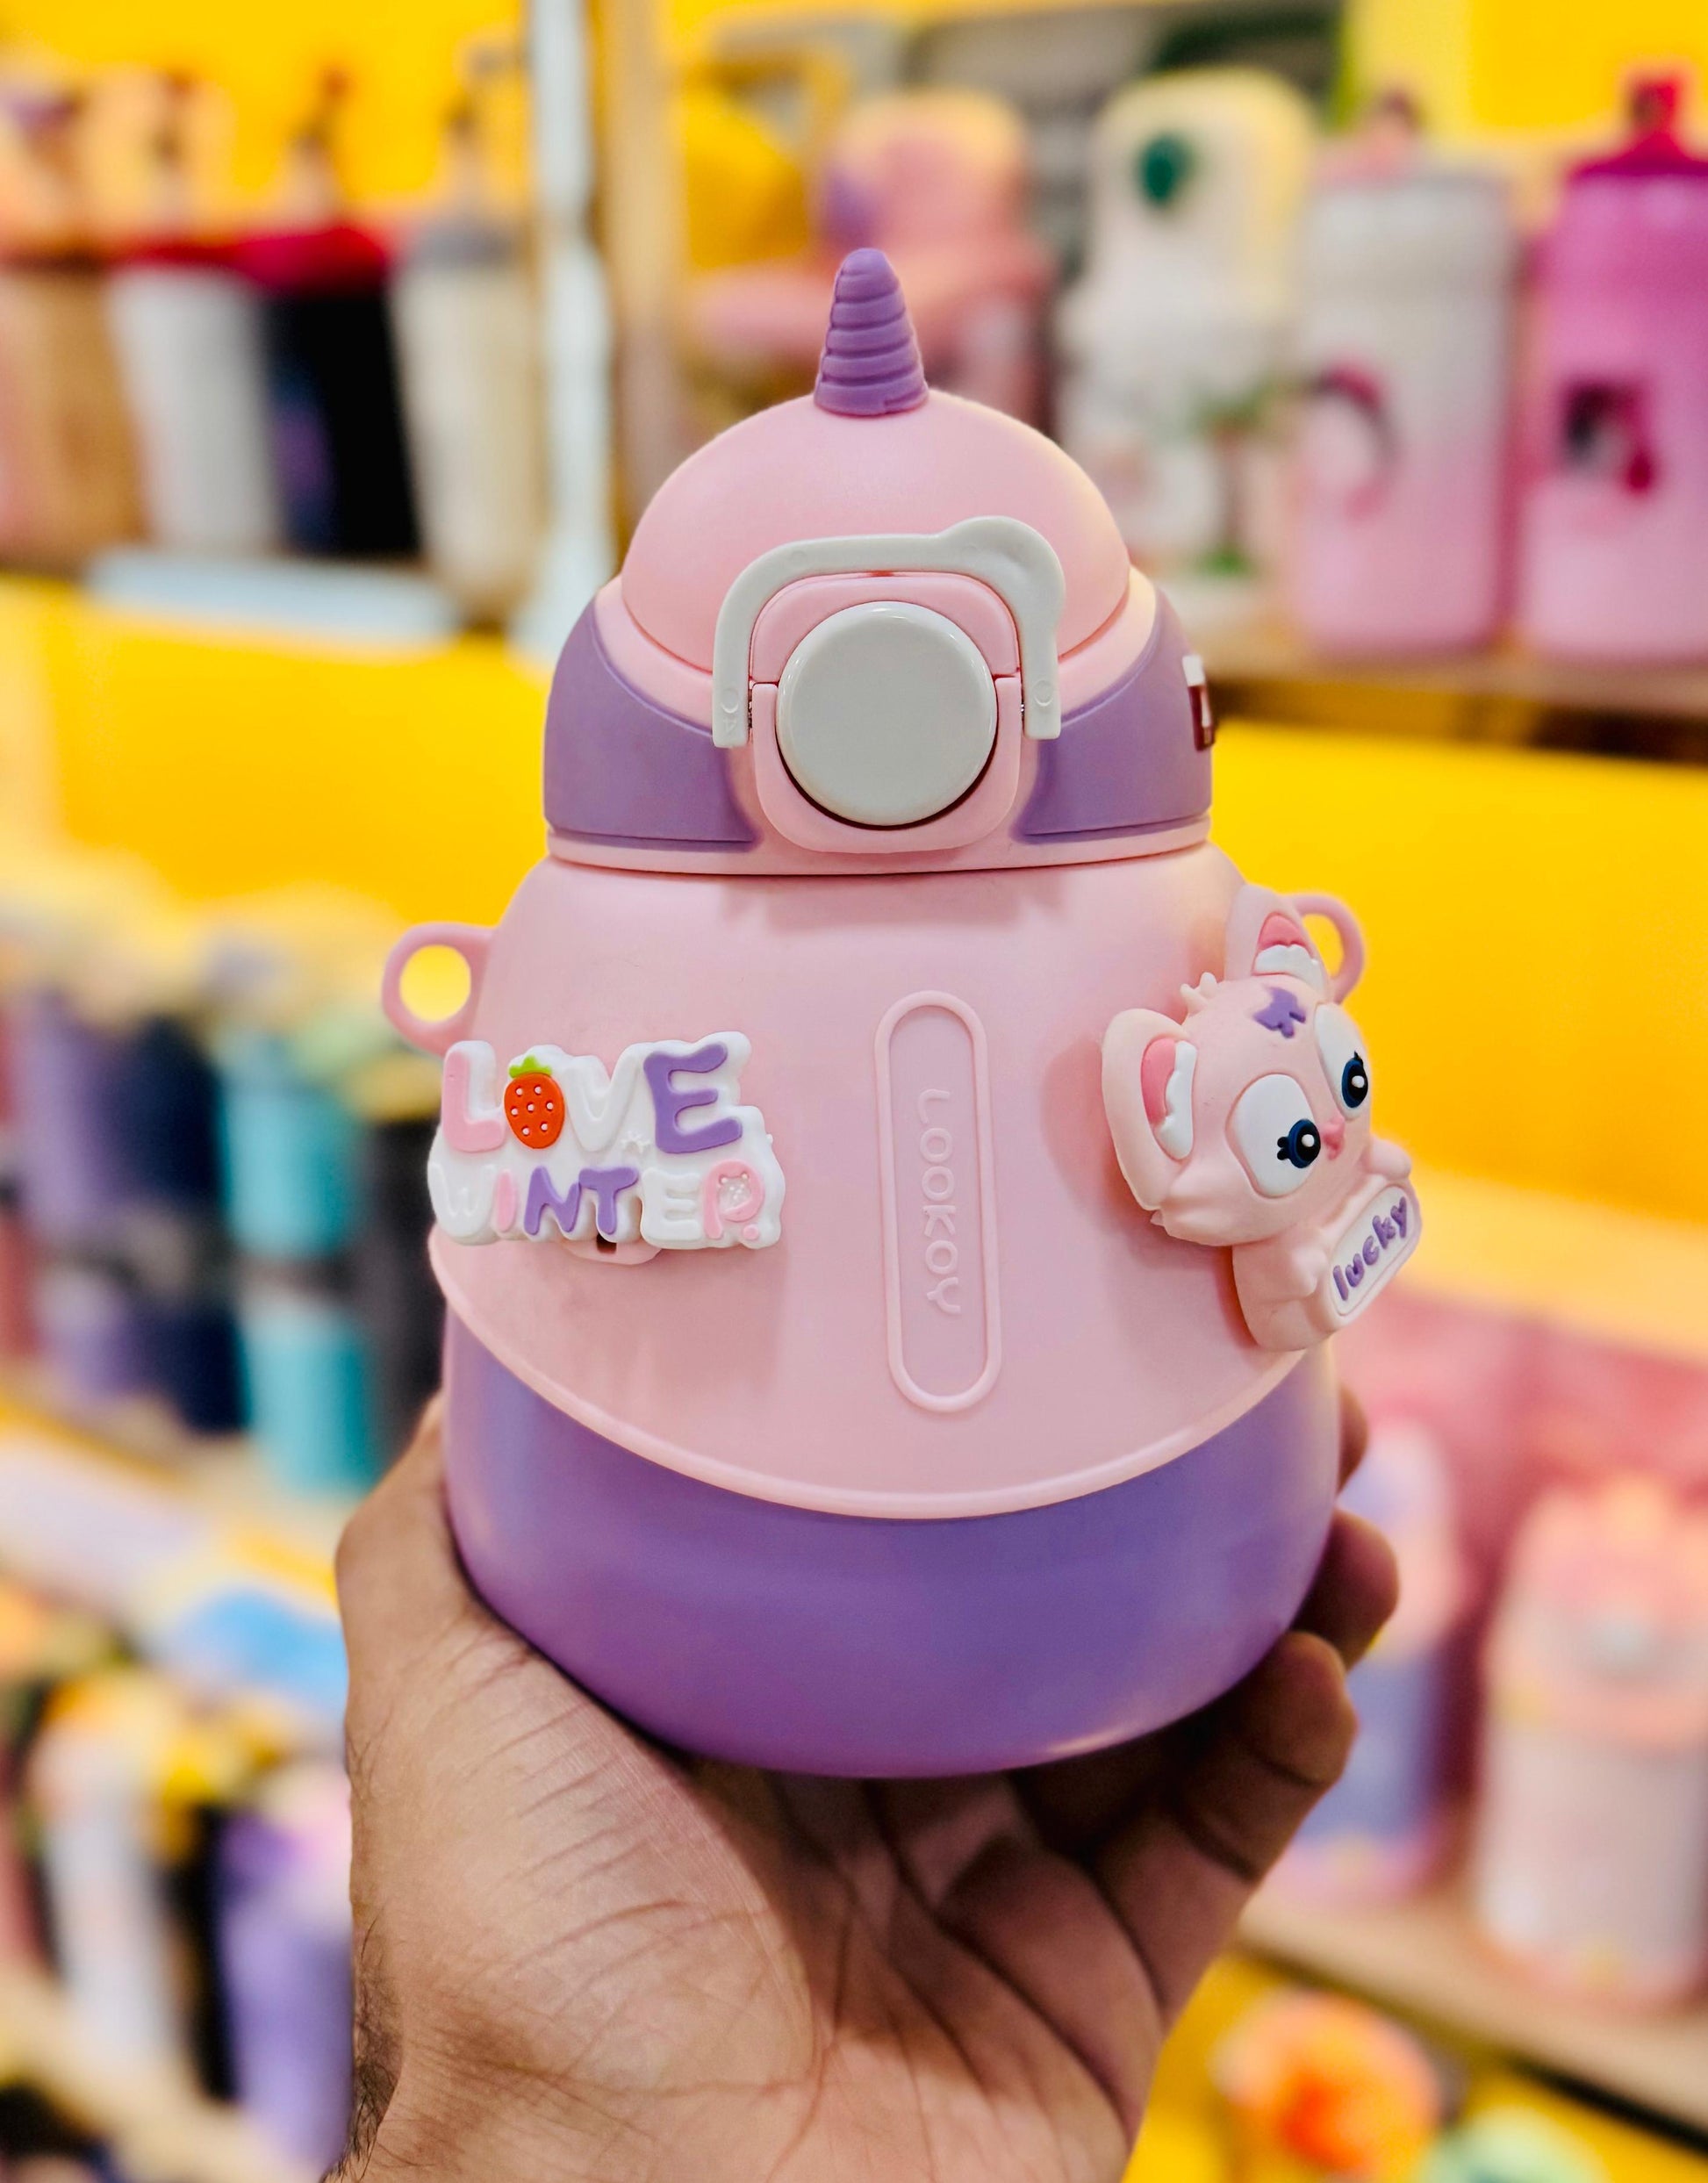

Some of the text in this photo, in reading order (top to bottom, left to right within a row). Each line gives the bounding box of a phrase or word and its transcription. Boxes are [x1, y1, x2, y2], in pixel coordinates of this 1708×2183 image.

[442, 1043, 743, 1154] LOVE
[917, 1088, 962, 1315] LOOKOY
[1332, 1196, 1407, 1301] lucky
